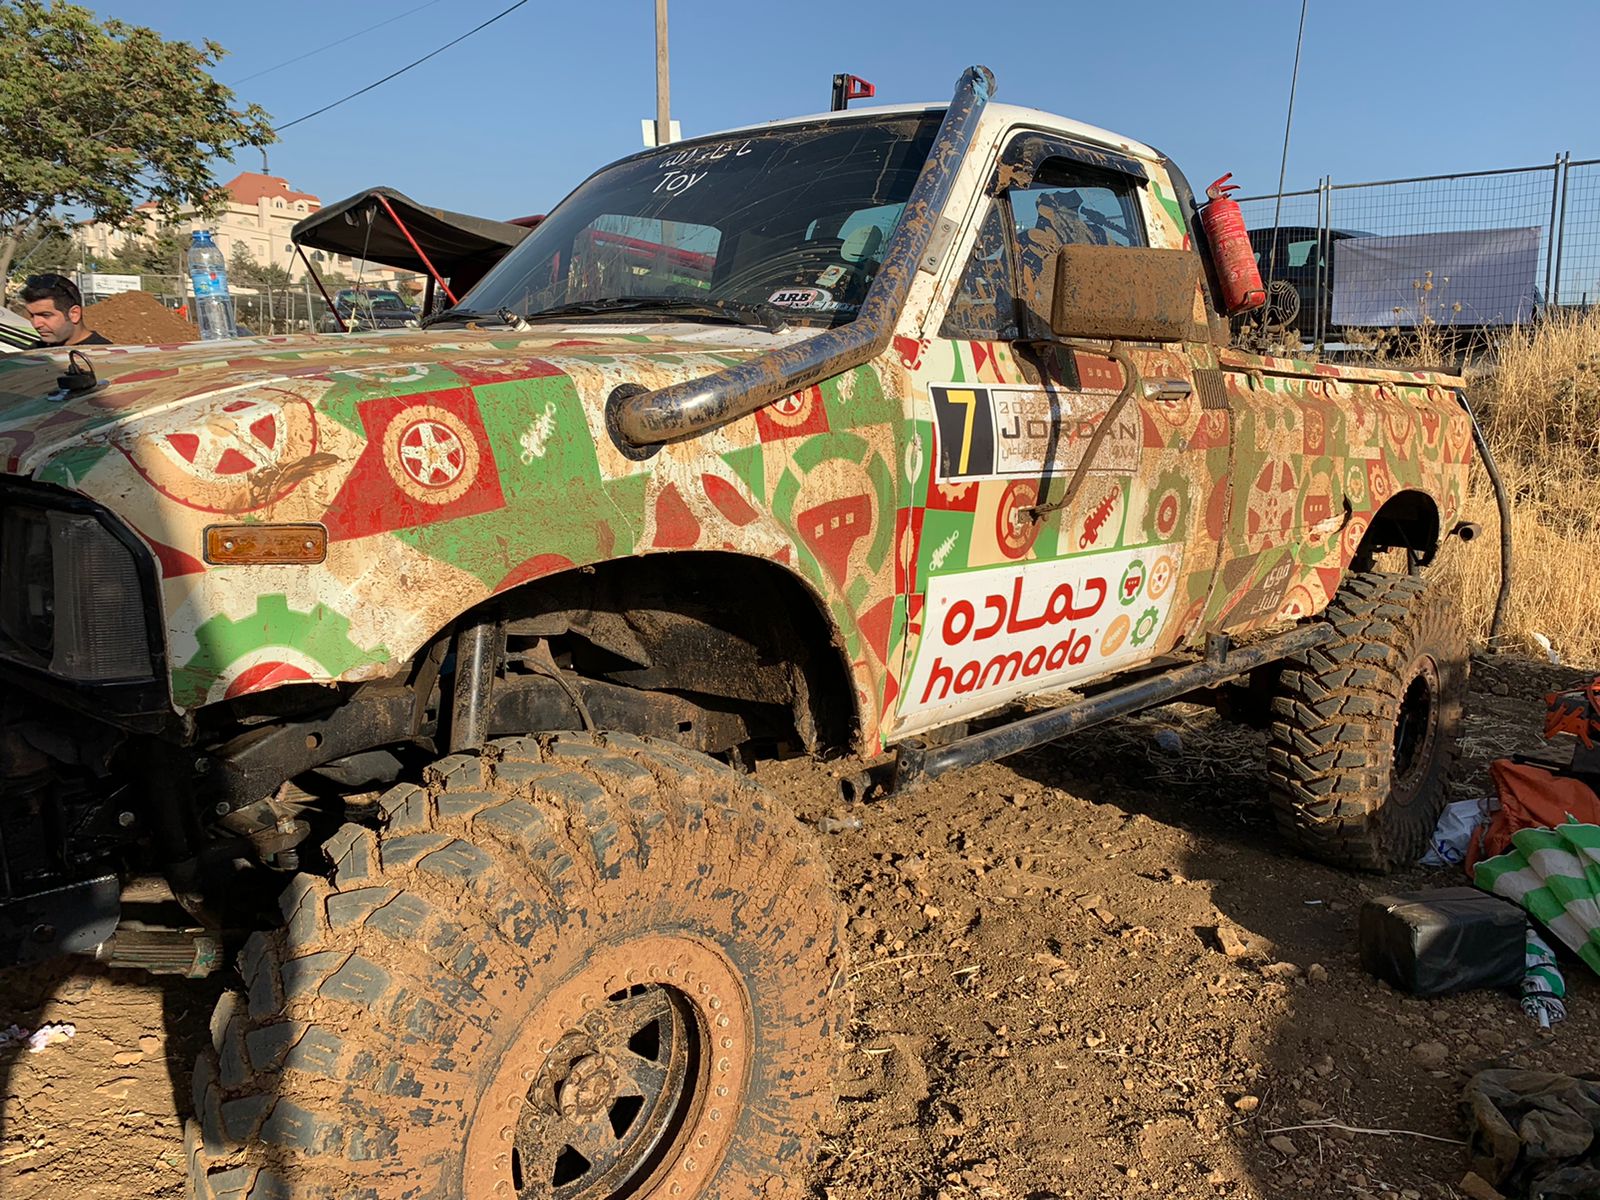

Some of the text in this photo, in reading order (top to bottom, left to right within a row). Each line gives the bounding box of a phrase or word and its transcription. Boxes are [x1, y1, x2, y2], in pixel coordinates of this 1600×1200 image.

[773, 292, 812, 303] ARB
[999, 401, 1049, 415] 2022
[946, 389, 977, 475] 7
[919, 628, 1092, 704] hamada
